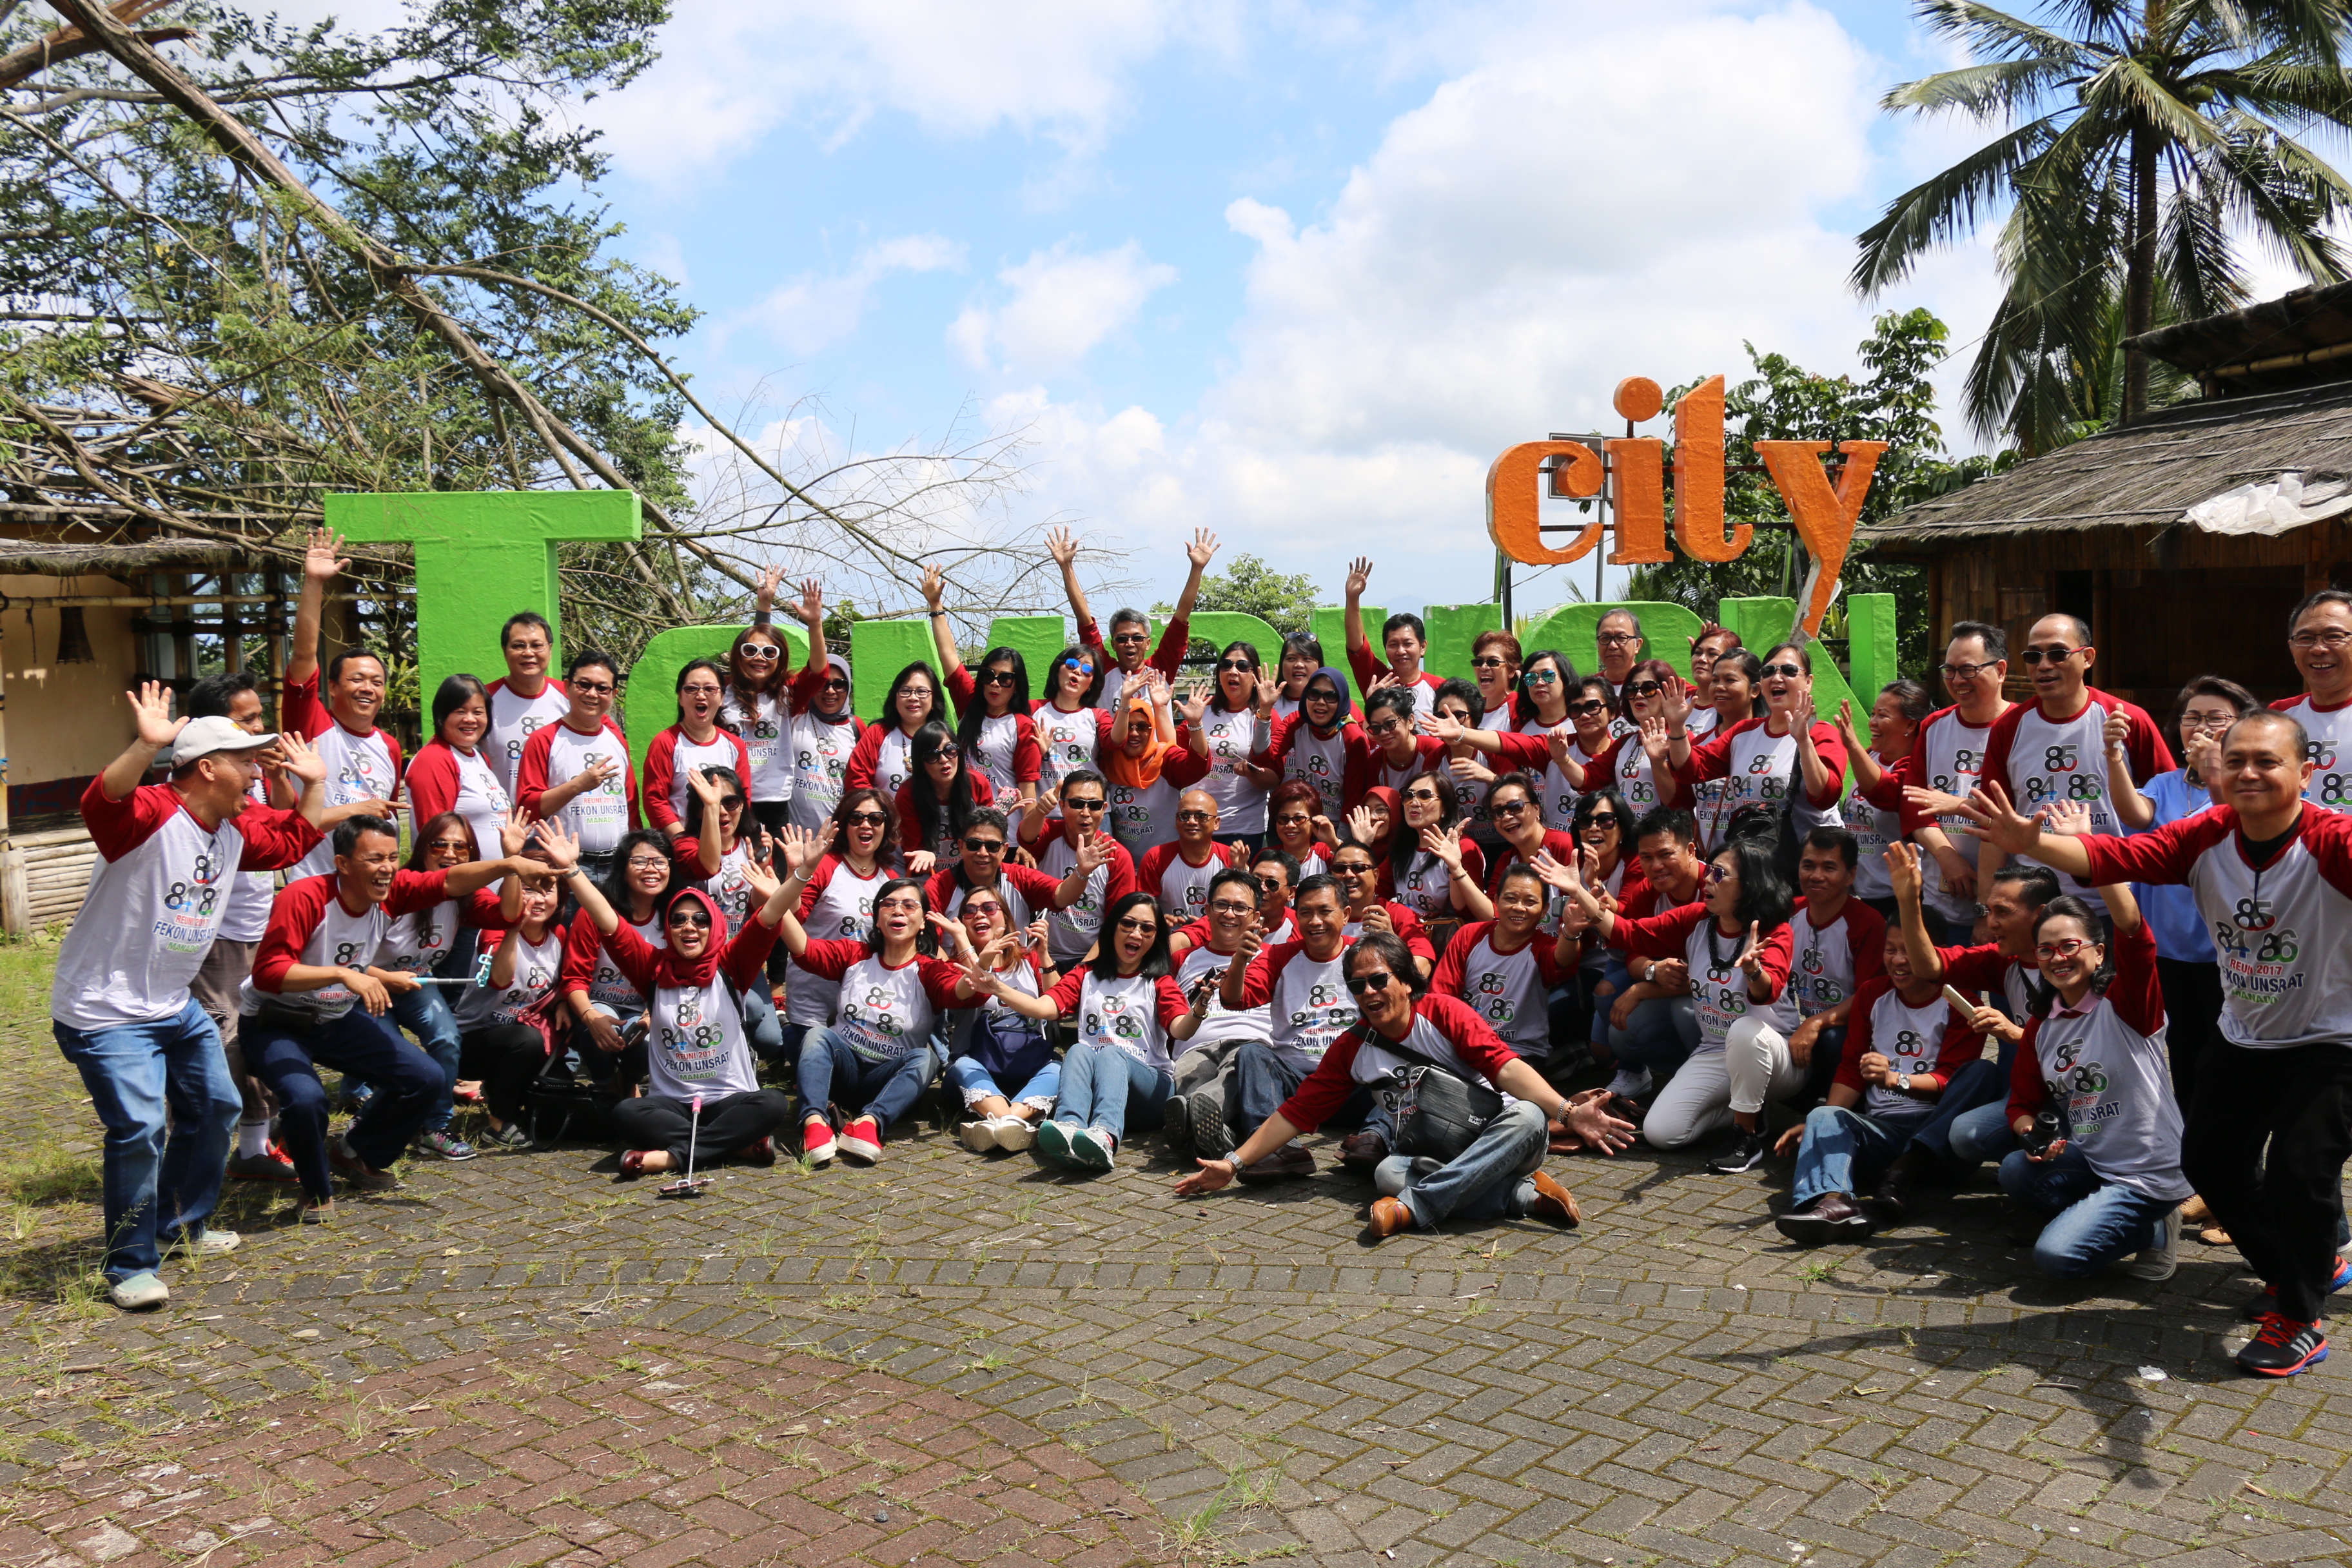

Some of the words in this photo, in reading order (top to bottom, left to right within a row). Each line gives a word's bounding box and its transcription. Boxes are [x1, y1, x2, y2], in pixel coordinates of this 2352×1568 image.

[1485, 373, 1888, 642] city
[754, 720, 779, 739] 86
[1052, 726, 1076, 743] 85
[1210, 723, 1233, 739] 85
[975, 750, 993, 768] 86
[1067, 744, 1091, 763] 86
[1215, 740, 1240, 759] 86
[2044, 743, 2079, 773] 85
[2308, 740, 2339, 772] 85
[798, 750, 821, 772] 84
[1308, 754, 1329, 776] 85
[1748, 754, 1778, 774] 85
[1954, 749, 1985, 776] 85
[807, 774, 825, 782] REUNI
[1040, 770, 1061, 779] FEKON
[602, 775, 623, 796] 86
[794, 778, 821, 792] FEKON
[1320, 778, 1341, 798] 86
[1455, 785, 1477, 805] 85
[1631, 781, 1654, 803] 86
[1694, 780, 1720, 801] 84
[1732, 775, 1754, 798] 84
[1760, 776, 1786, 799] 86
[2026, 774, 2058, 803] 84
[2067, 772, 2102, 801] 86
[2320, 772, 2352, 805] 86
[1113, 787, 1135, 805] 85
[570, 806, 598, 816] FEKON
[600, 805, 627, 814] UNSRAT
[1127, 805, 1150, 822] 86
[1126, 825, 1154, 836] UNSRAT
[721, 869, 745, 893] 85
[164, 882, 192, 912] 84
[1185, 885, 1208, 905] 85
[1418, 894, 1438, 912] 86
[175, 915, 194, 925] REUNI
[2233, 897, 2276, 931] 85
[153, 921, 186, 940] FEKON
[839, 916, 865, 937] 84
[166, 942, 199, 952] MANADO
[2216, 921, 2251, 959] 84
[2256, 928, 2298, 963] 86
[1801, 947, 1825, 975] 85
[2230, 958, 2253, 975] REUNI
[2257, 965, 2283, 975] 2017
[527, 966, 548, 989] 85
[597, 967, 625, 986] 84
[1478, 972, 1507, 995] 85
[2250, 973, 2305, 993] UNSRAT
[502, 990, 530, 1008] 84
[590, 989, 620, 1002] FEKON
[607, 986, 627, 995] REUNI
[865, 986, 896, 1010] 85
[1309, 984, 1338, 1008] 85
[1689, 977, 1712, 1004] 84
[1719, 988, 1747, 1014] 86
[1813, 977, 1843, 1003] 86
[2231, 990, 2278, 1004] MANADO
[1101, 995, 1129, 1014] 85
[1489, 997, 1515, 1022] 86
[1702, 1005, 1720, 1016] REUNI
[843, 1003, 869, 1026] 84
[876, 1012, 906, 1037] 86
[1085, 1012, 1108, 1036] 84
[1115, 1014, 1143, 1038] 86
[1291, 1010, 1320, 1028] 84
[1328, 1007, 1358, 1028] 86
[1487, 1019, 1503, 1029] 2017
[661, 1027, 688, 1051] 84
[695, 1021, 724, 1049] 86
[841, 1026, 868, 1046] FEKON
[868, 1041, 904, 1057] UNSRAT
[874, 1033, 892, 1043] 2017
[1291, 1036, 1320, 1050] FEKON
[1894, 1029, 1924, 1058] 85
[665, 1058, 692, 1072] FEKON
[695, 1052, 730, 1071] UNSRAT
[676, 1052, 697, 1060] REUNI
[851, 1044, 885, 1060] MANADO
[2053, 1037, 2084, 1073] 85
[679, 1070, 716, 1081] MANADO
[2074, 1061, 2108, 1094] 86
